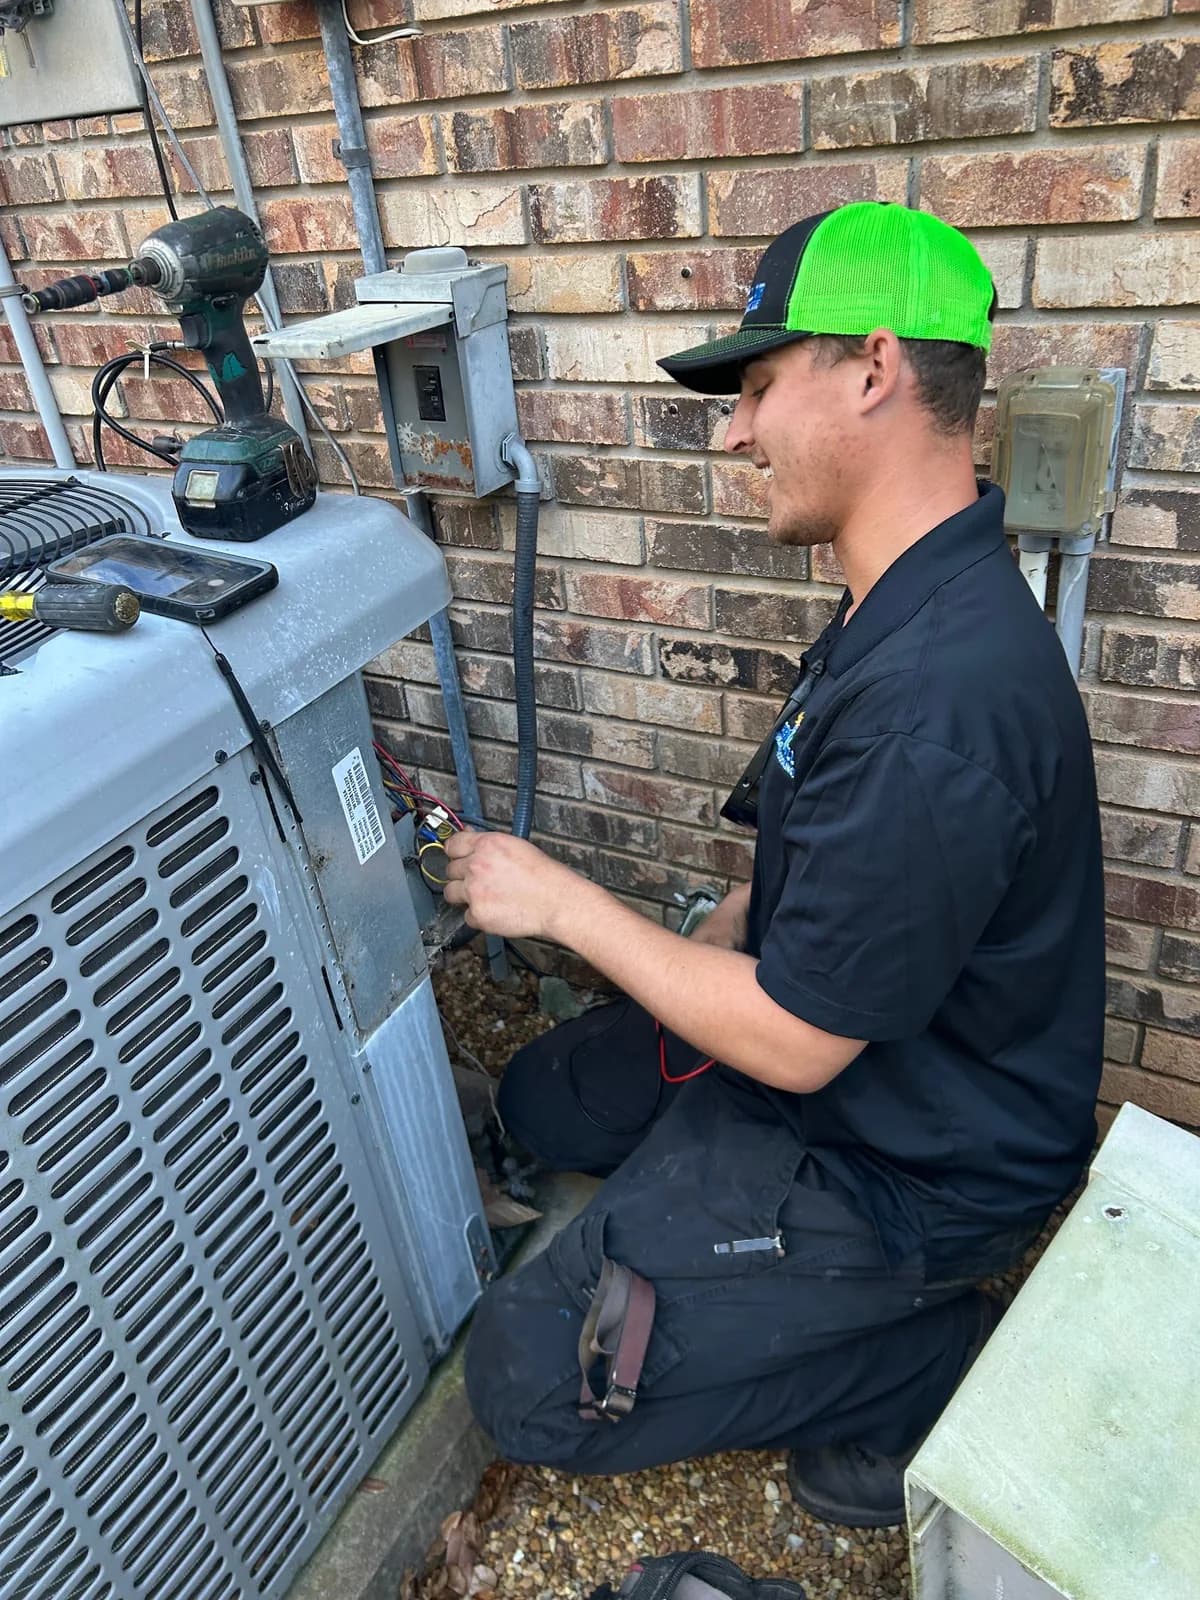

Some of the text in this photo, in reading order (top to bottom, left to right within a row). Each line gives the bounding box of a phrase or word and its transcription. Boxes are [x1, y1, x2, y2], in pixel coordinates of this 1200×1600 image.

[353, 822, 361, 843] Number
[357, 819, 366, 839] Number
[362, 816, 370, 836] Number
